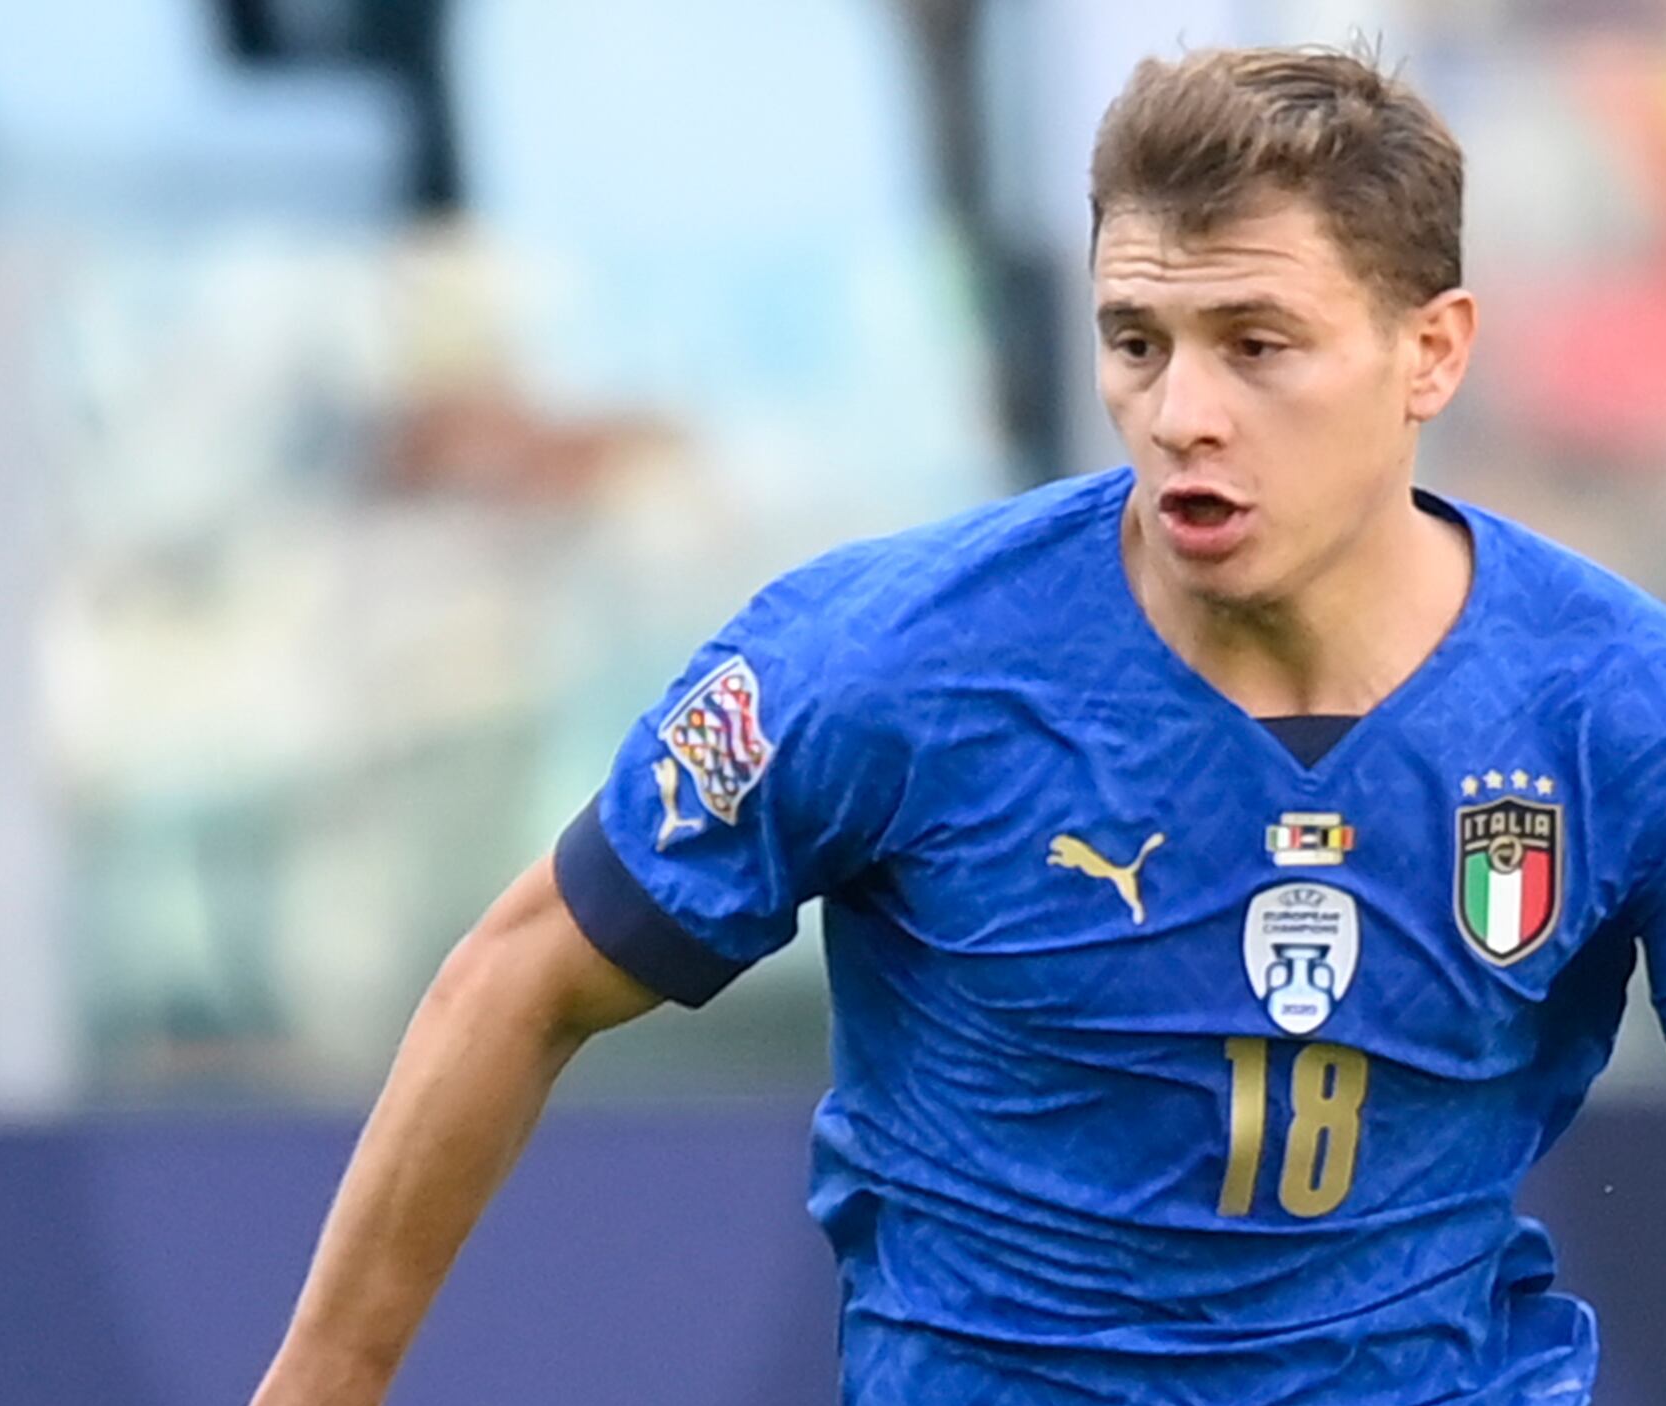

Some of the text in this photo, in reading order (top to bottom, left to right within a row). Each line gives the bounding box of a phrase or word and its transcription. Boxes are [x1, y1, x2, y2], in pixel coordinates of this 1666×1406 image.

[1464, 811, 1551, 840] ITALIA
[1262, 911, 1341, 922] EUROPEAN
[1216, 1036, 1369, 1218] 18
